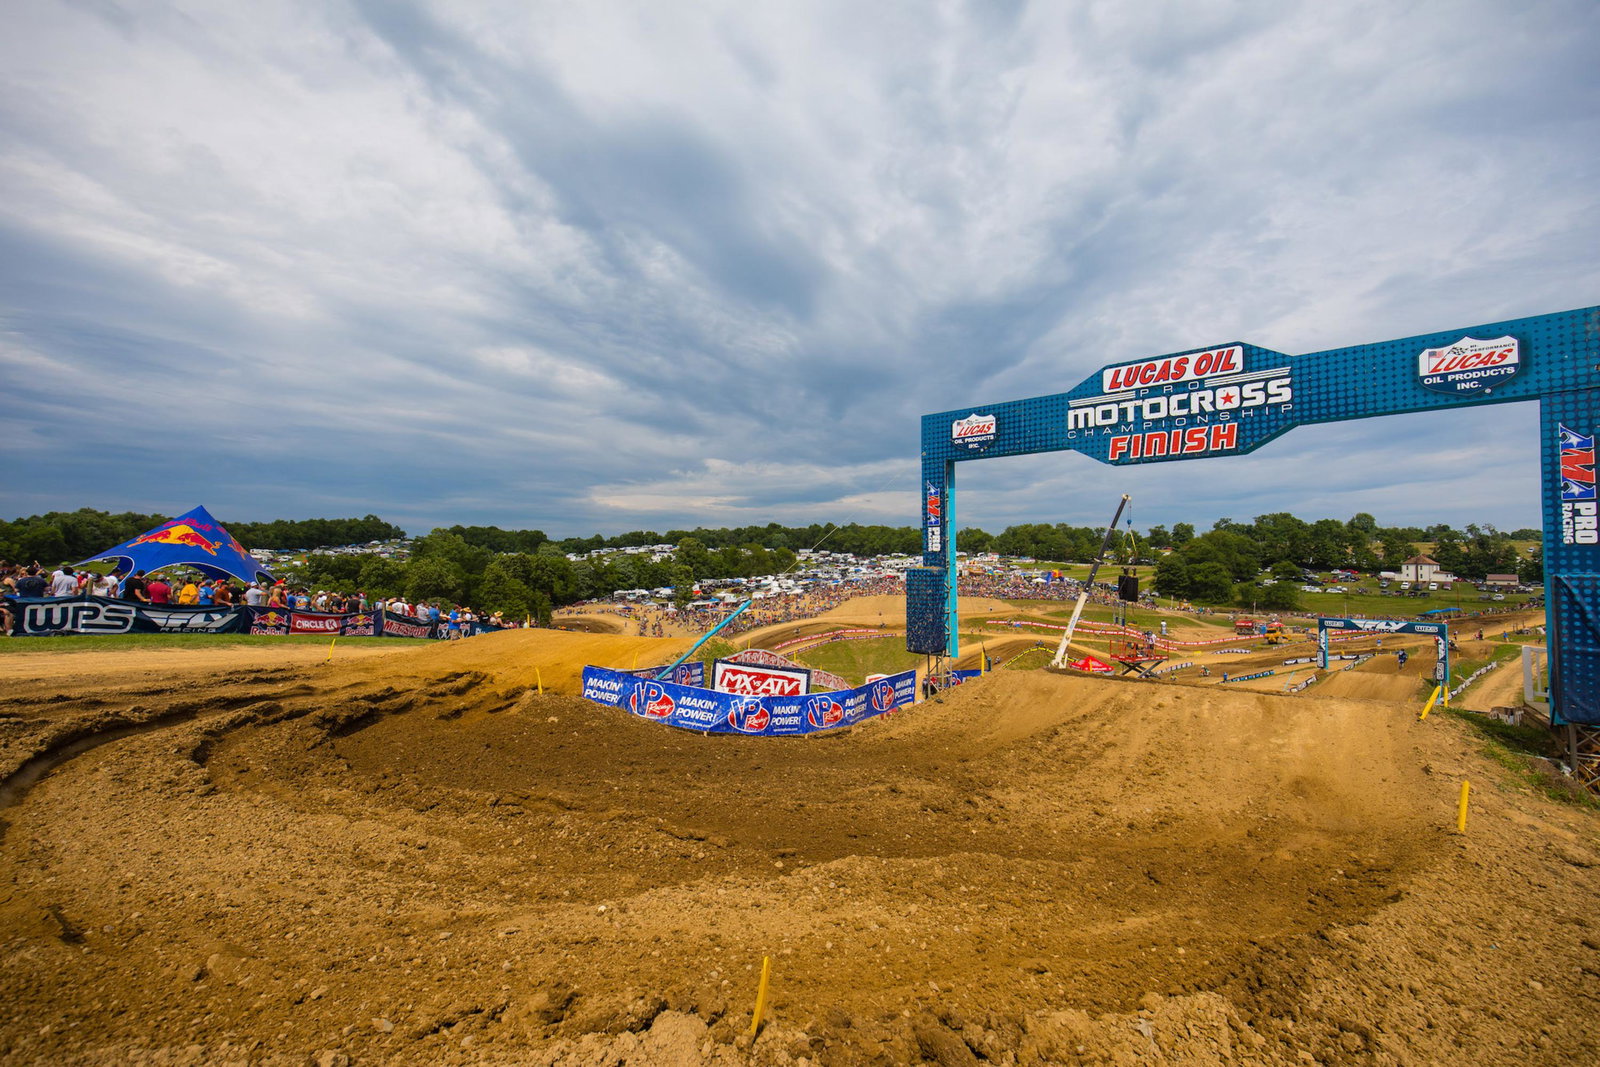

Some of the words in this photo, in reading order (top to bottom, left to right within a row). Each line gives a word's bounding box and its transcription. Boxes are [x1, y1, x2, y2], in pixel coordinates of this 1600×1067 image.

[1108, 356, 1189, 390] LUCAS
[1194, 348, 1237, 376] OIL
[1428, 348, 1514, 374] LUCAS
[1423, 376, 1444, 385] OIL
[1447, 366, 1515, 382] PRODUCTS
[1456, 381, 1482, 390] INC.
[1140, 381, 1199, 397] PRO
[1067, 378, 1292, 430] MOTOCROSS
[957, 422, 994, 437] LUCAS
[1067, 404, 1292, 439] CHAMPIONSHIP
[965, 434, 994, 443] PRODUCTS
[1108, 423, 1238, 461] FINISH
[1559, 422, 1597, 501] AMA
[1562, 502, 1574, 544] RACING
[1574, 502, 1598, 544] PRO
[23, 602, 136, 634] WPS
[142, 610, 240, 628] FLY
[296, 619, 325, 630] CIRCLE
[325, 618, 338, 631] K
[586, 677, 623, 692] MAKIN'
[721, 671, 757, 692] MX
[756, 677, 800, 695] ATV
[583, 688, 620, 703] POWER!
[635, 681, 665, 718] VP
[679, 696, 718, 710] MAKIN'
[676, 707, 717, 723] POWER!
[731, 698, 762, 732] VP
[772, 705, 801, 715] MAKIN'
[808, 696, 833, 727] VP
[770, 716, 802, 726] POWER!
